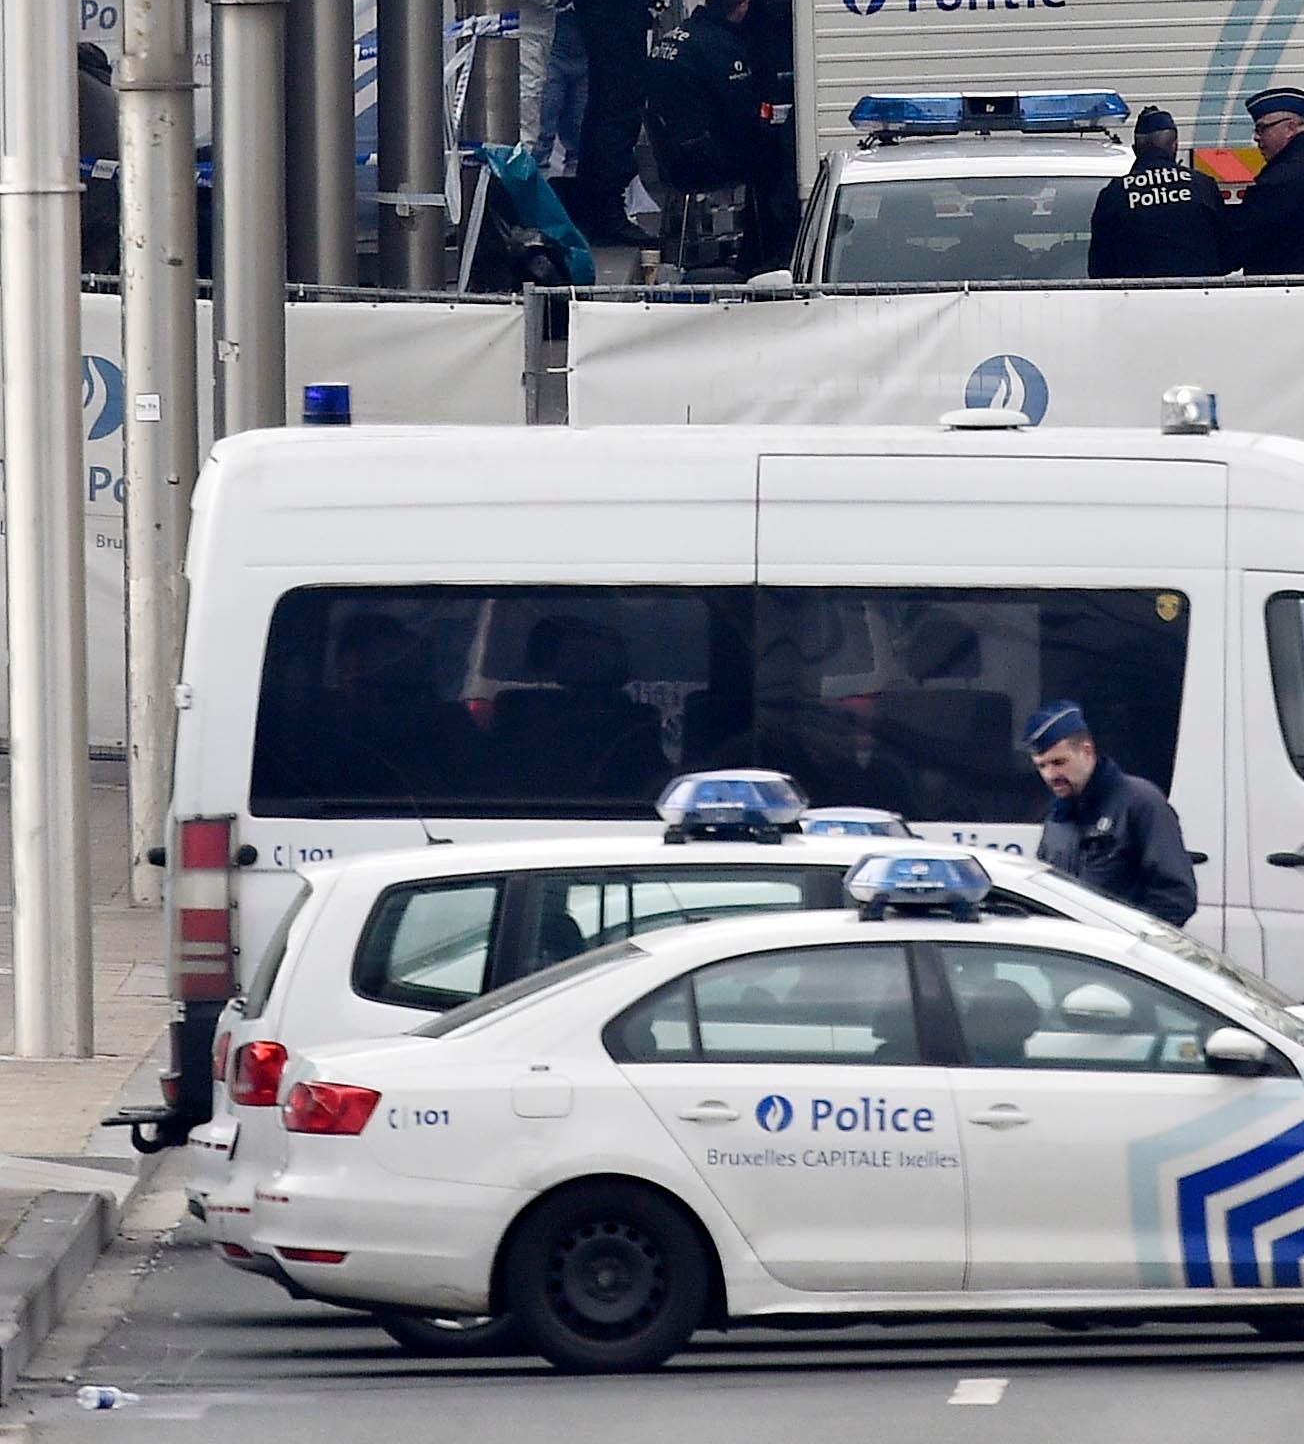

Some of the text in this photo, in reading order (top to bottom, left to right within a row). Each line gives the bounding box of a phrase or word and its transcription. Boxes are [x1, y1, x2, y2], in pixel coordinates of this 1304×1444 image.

[1123, 167, 1192, 189] Politie
[1128, 187, 1192, 209] Police
[299, 848, 333, 863] 101
[412, 1109, 450, 1126] 101
[811, 1096, 935, 1133] Police
[706, 1148, 960, 1168] Bruxelles CAPITALE Ixelles
